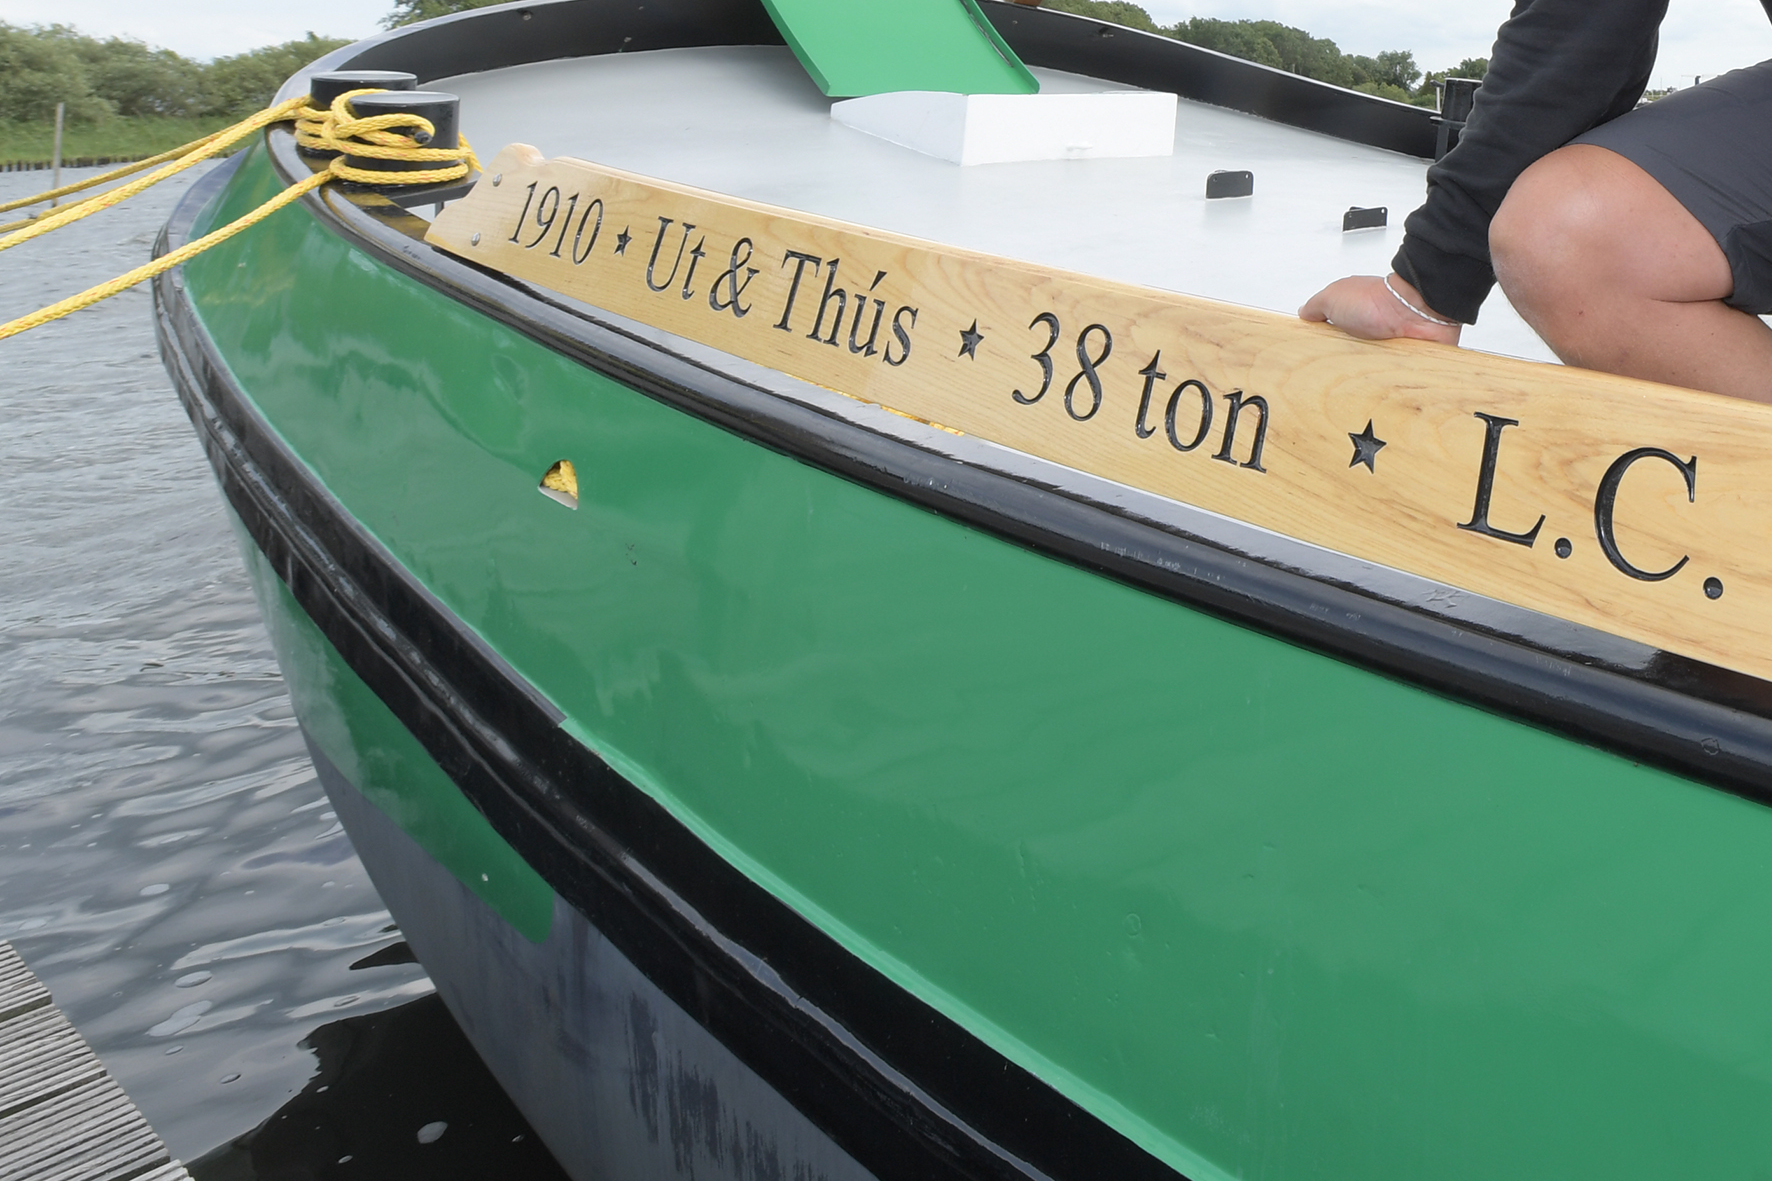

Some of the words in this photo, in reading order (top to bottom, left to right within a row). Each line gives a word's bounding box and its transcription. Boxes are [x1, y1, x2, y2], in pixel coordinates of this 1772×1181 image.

[508, 180, 605, 267] 1910
[645, 215, 707, 301] Ut
[708, 236, 761, 319] &
[772, 247, 920, 368] Thús
[1010, 310, 1113, 423] 38
[1134, 348, 1272, 474] ton
[1456, 410, 1726, 601] L.C.
